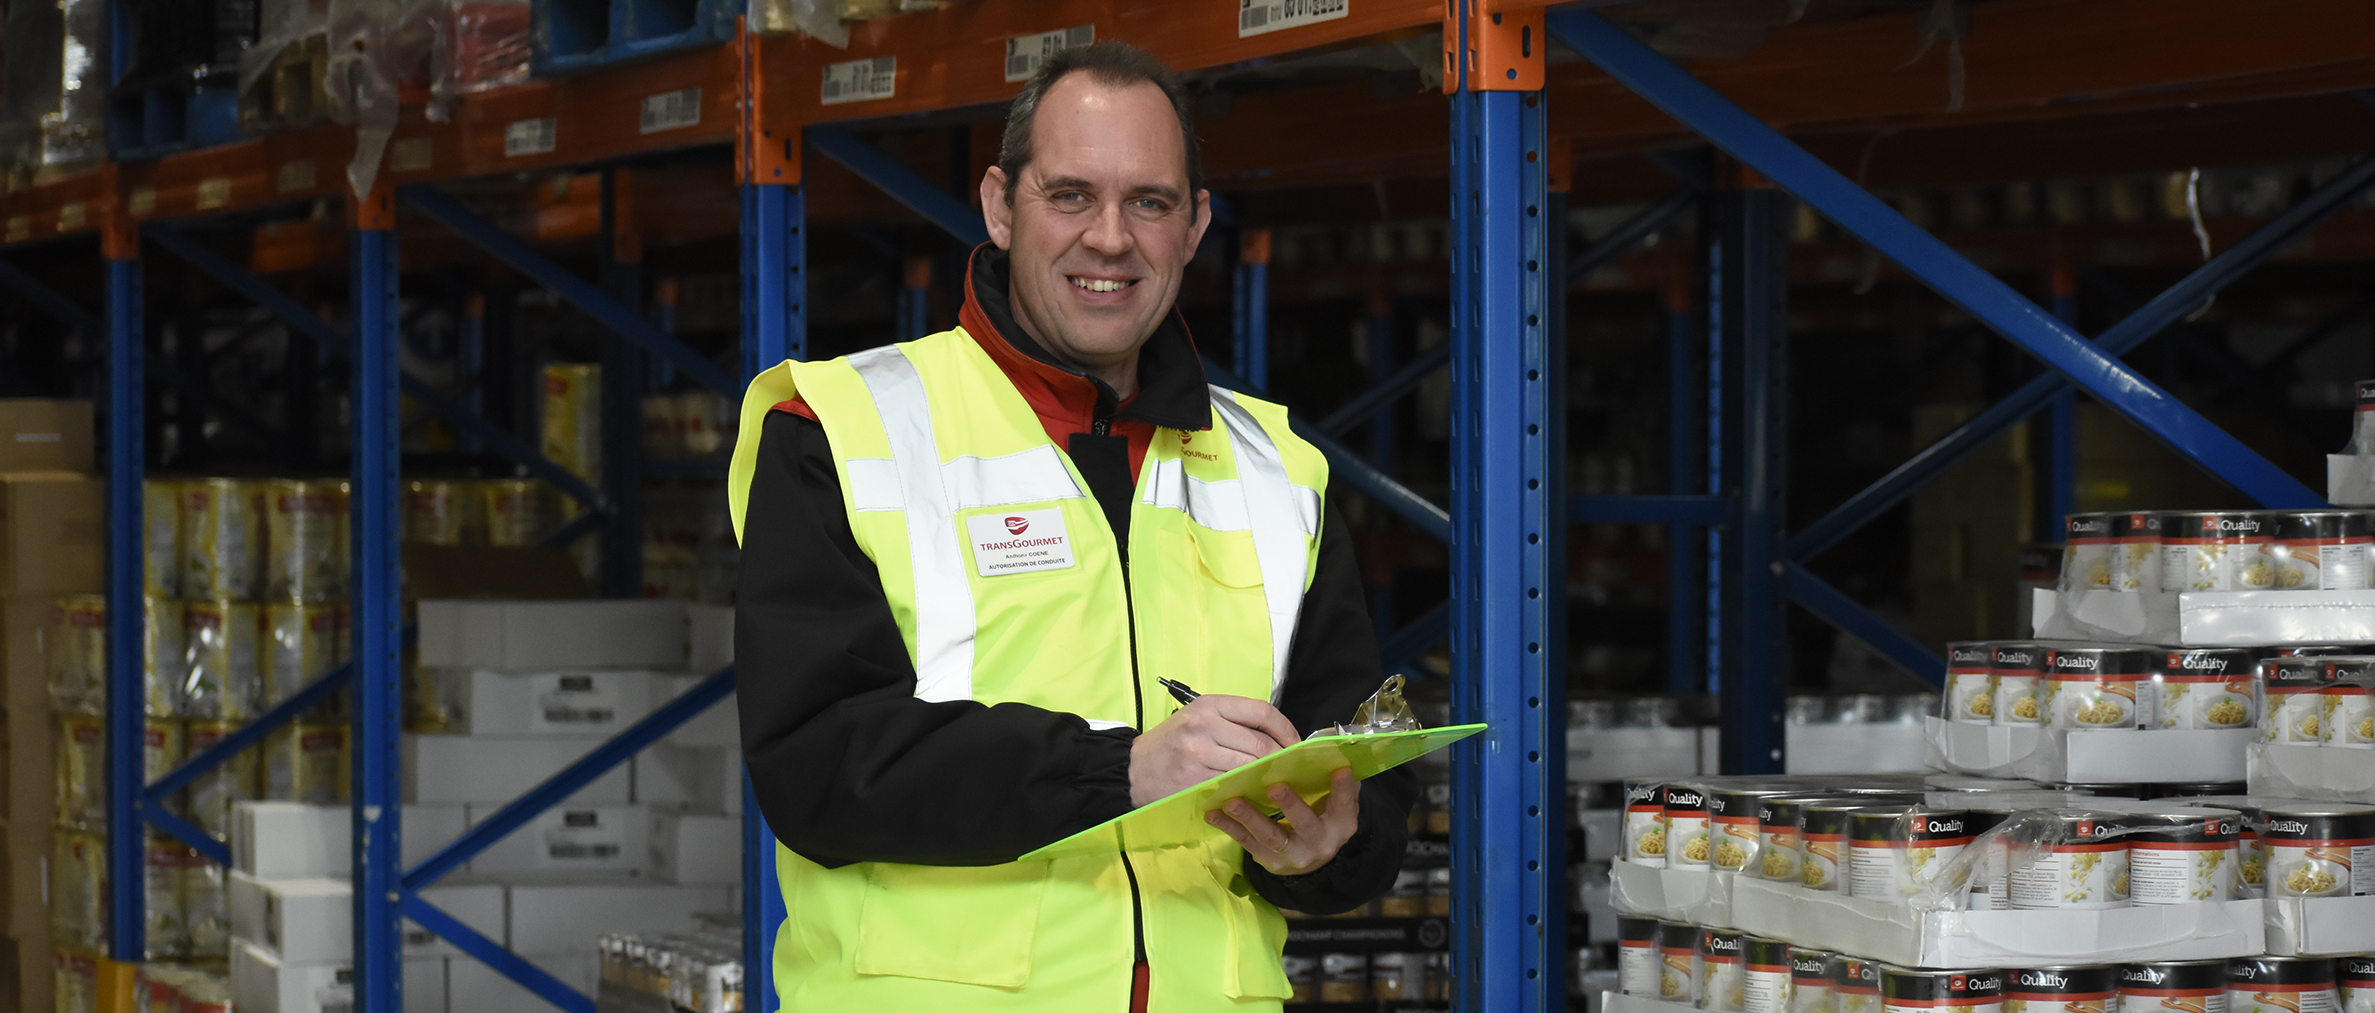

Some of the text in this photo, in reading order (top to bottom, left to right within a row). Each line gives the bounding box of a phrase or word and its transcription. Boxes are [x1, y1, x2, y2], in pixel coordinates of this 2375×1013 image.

[2220, 518, 2261, 533] Quality
[989, 561, 1028, 570] AUTORISATION
[1038, 558, 1066, 566] CONDUITE
[1997, 652, 2033, 665] Quality
[2056, 656, 2099, 670] Quality
[2183, 658, 2228, 671] Quality
[1668, 792, 1703, 807] Quality
[1928, 820, 1964, 833] Quality
[2271, 819, 2308, 835] Quality
[1793, 959, 1826, 975] Quality
[1969, 976, 2001, 992] Quality
[2020, 973, 2068, 990] Quality
[2121, 969, 2164, 985] Quality
